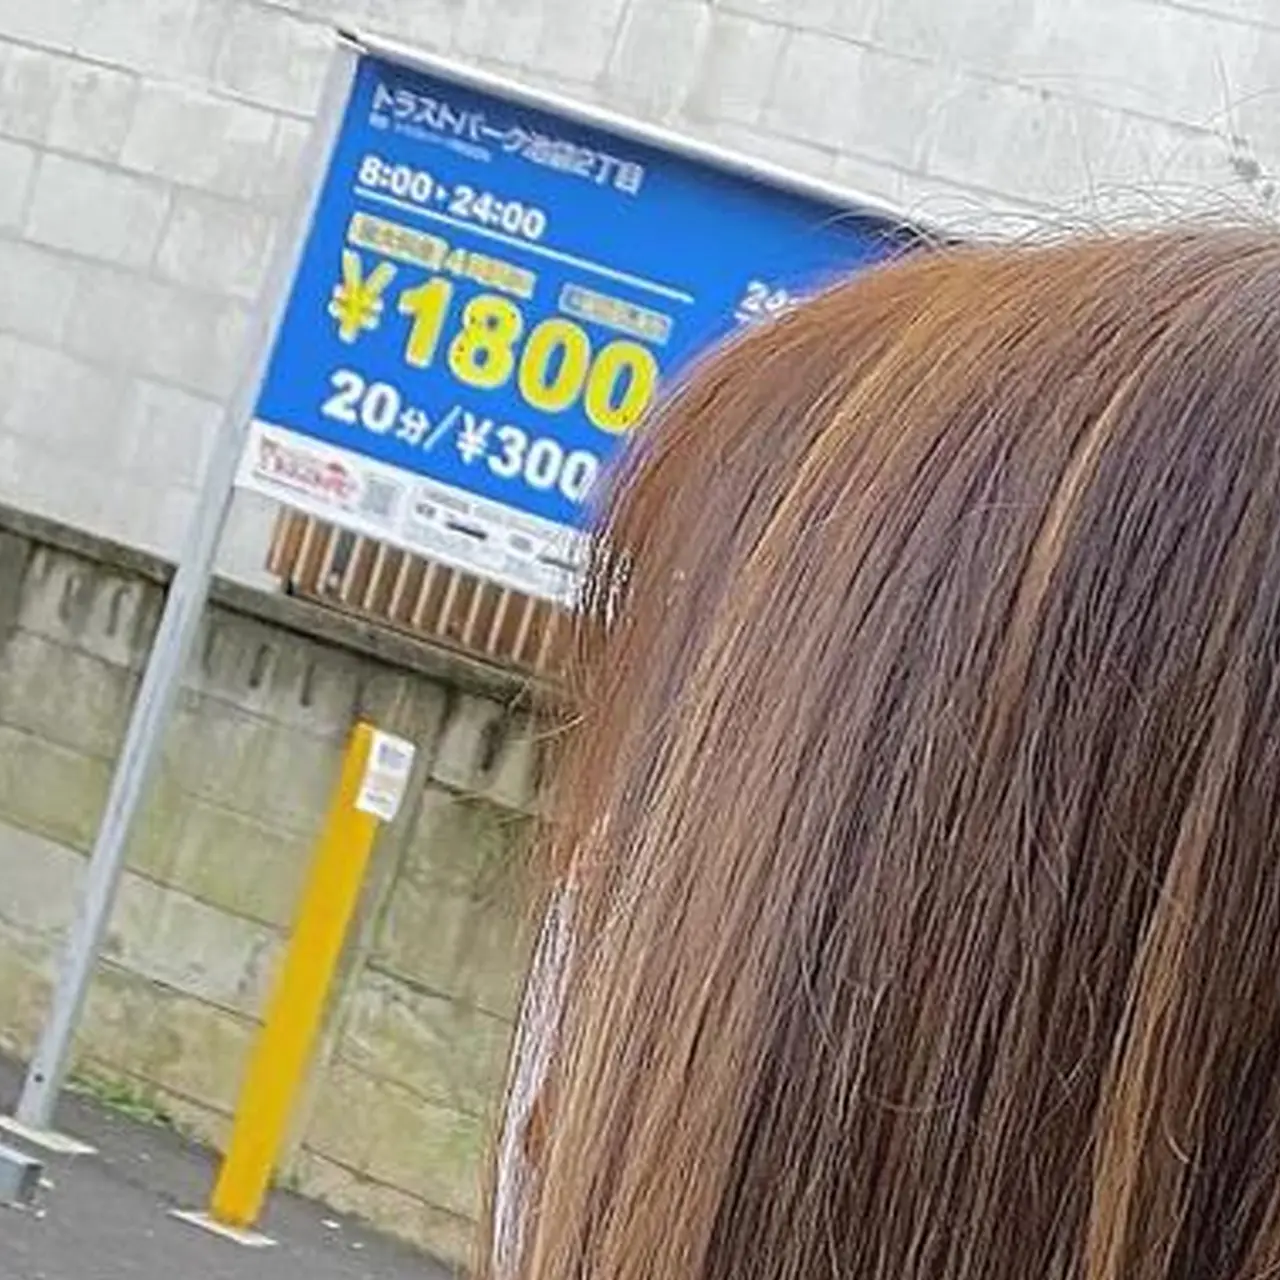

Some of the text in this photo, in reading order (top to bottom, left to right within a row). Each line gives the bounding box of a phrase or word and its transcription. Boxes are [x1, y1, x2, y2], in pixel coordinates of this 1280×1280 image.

[358, 154, 547, 240] 8:00 24:00
[327, 247, 659, 435] ¥1800
